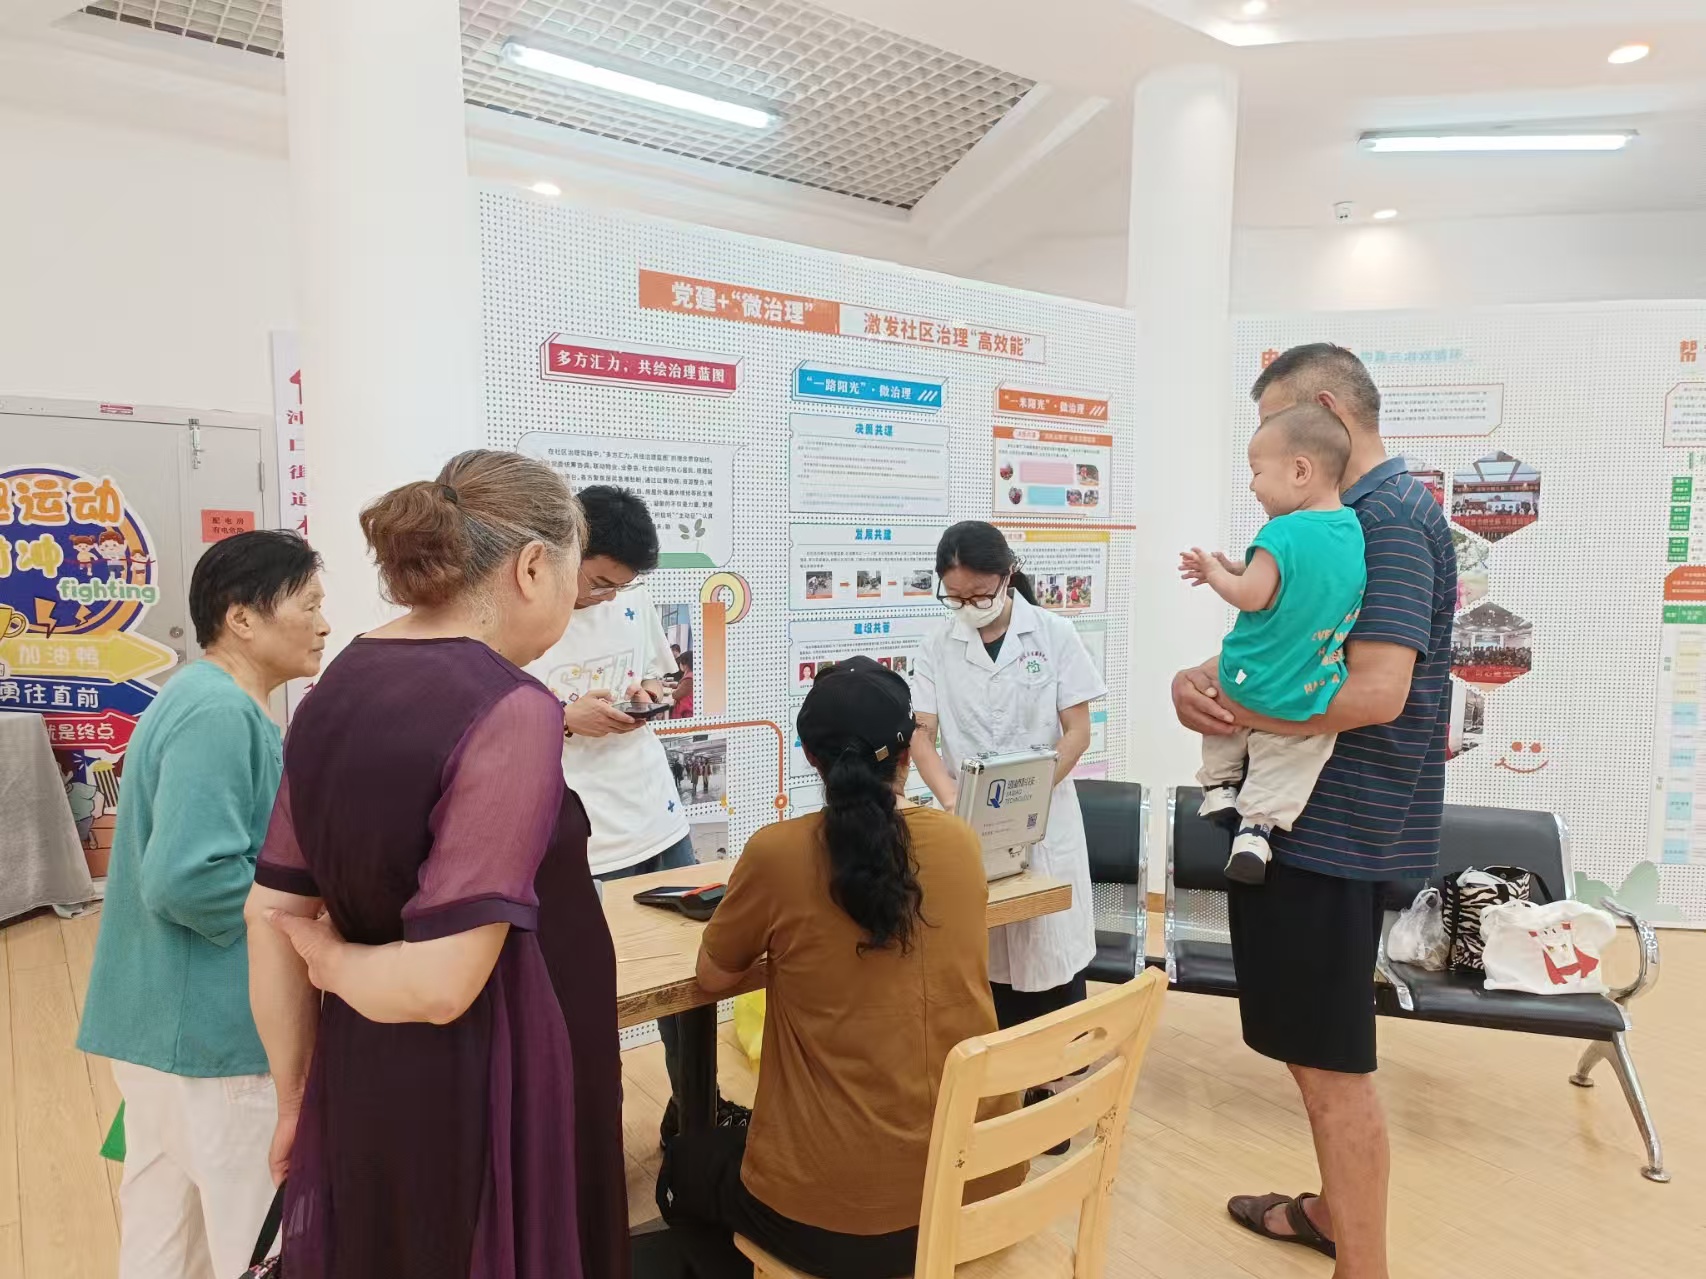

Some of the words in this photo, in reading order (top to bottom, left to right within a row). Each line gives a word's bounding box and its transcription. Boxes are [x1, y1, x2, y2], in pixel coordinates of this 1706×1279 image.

[671, 281, 814, 325] 党建+“微治理”
[864, 312, 1031, 357] 激发社区治理“高效能”
[556, 349, 726, 383] 多方汇力，共绘治理蓝图
[0, 479, 121, 522] 运动
[0, 536, 60, 576] 冲
[59, 579, 156, 600] fighting
[19, 644, 99, 668] 加油鸭
